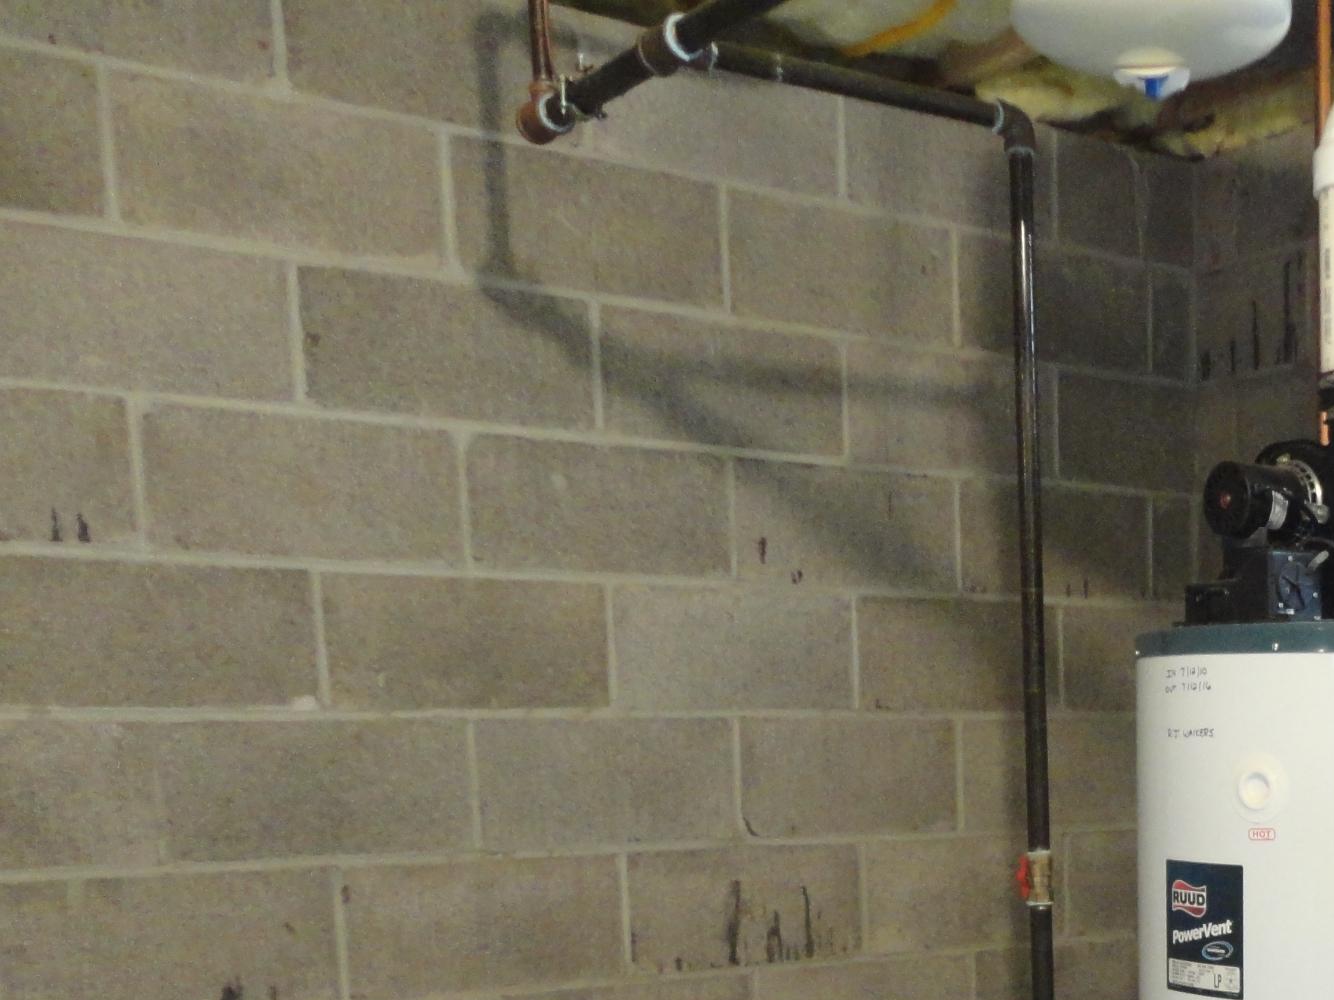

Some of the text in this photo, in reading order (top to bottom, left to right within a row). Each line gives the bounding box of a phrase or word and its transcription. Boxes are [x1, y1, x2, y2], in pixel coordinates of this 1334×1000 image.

[1252, 830, 1272, 838] HOT
[1172, 890, 1206, 907] RUUD
[1172, 919, 1233, 944] PowerVent
[1213, 974, 1222, 988] LP
